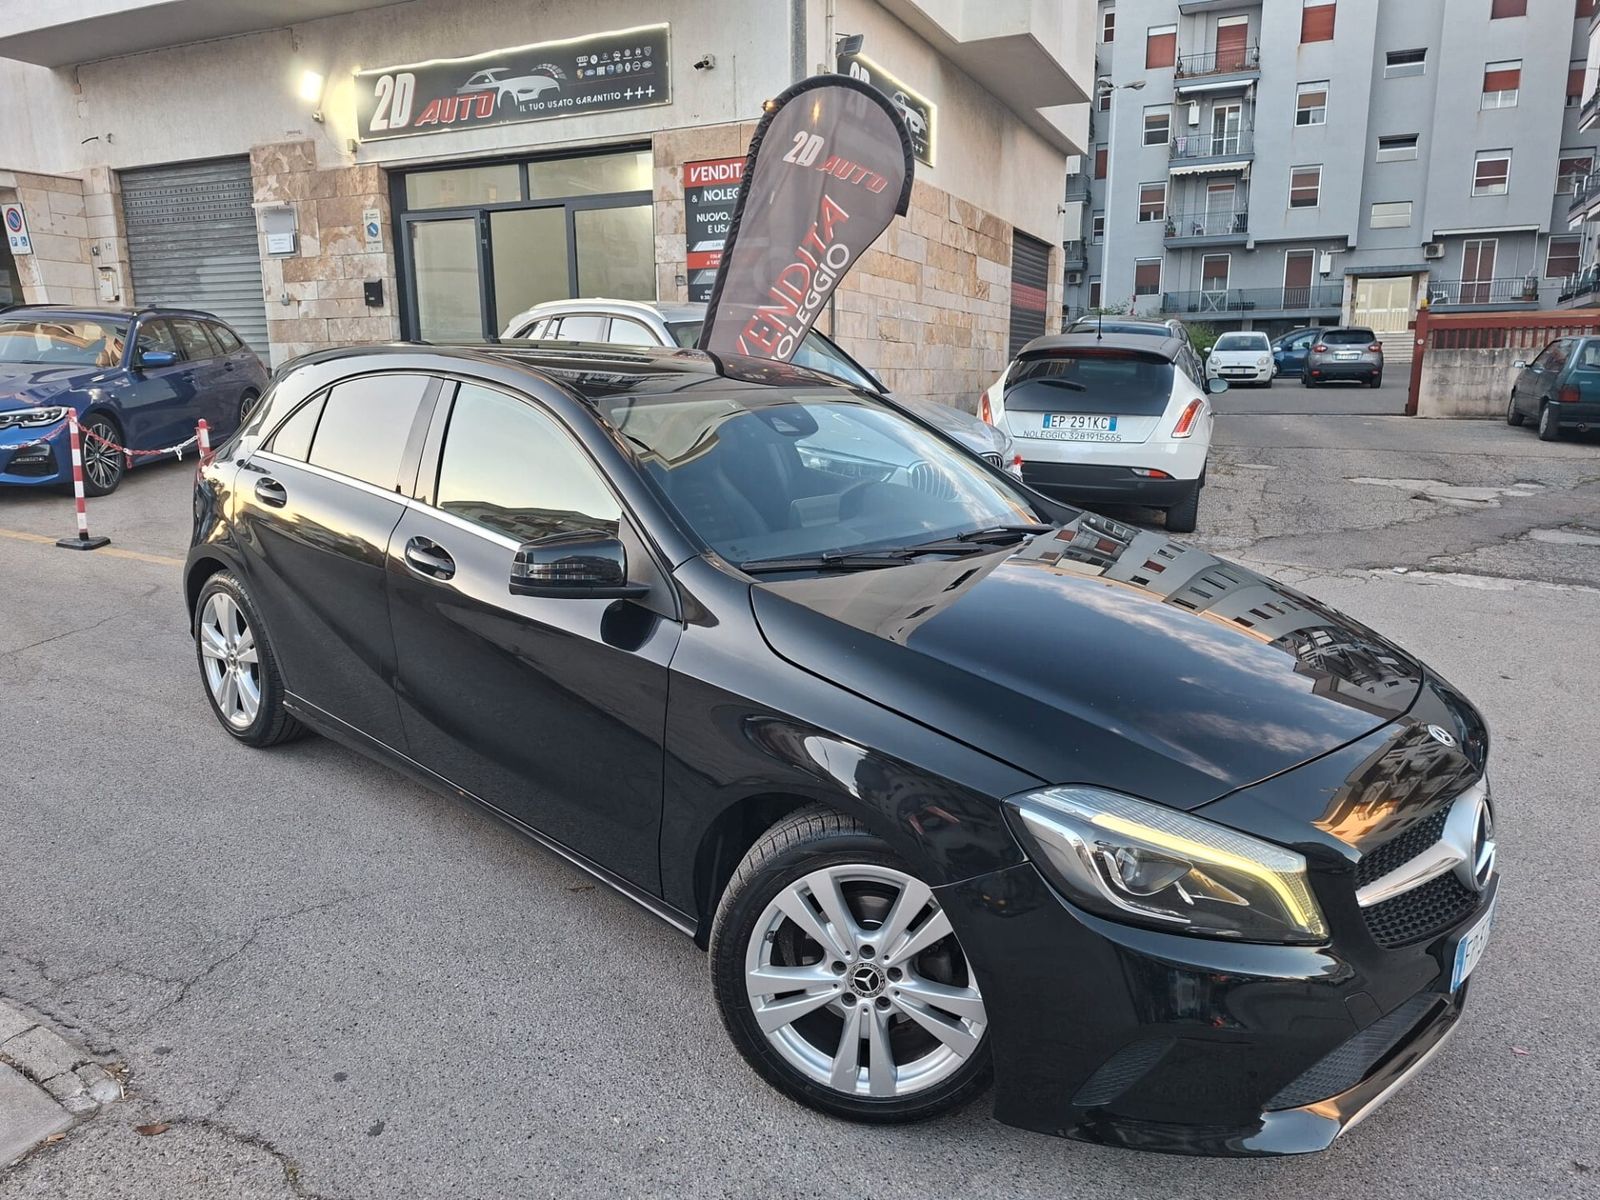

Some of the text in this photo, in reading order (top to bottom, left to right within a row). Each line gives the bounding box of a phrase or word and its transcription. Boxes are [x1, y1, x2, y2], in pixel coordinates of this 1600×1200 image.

[369, 72, 496, 132] 2D AUTO
[519, 105, 526, 113] IL
[529, 102, 545, 111] TUO
[547, 97, 574, 109] USATO
[575, 92, 621, 106] GARANTITO
[690, 162, 743, 183] VENDIT
[782, 130, 888, 194] 2D AUTO
[691, 187, 740, 203] & NOLEG
[707, 224, 713, 234] E
[770, 243, 850, 363] OLEGGIO
[1051, 415, 1108, 430] EP 291KC
[1023, 430, 1067, 440] NOLEGGIO
